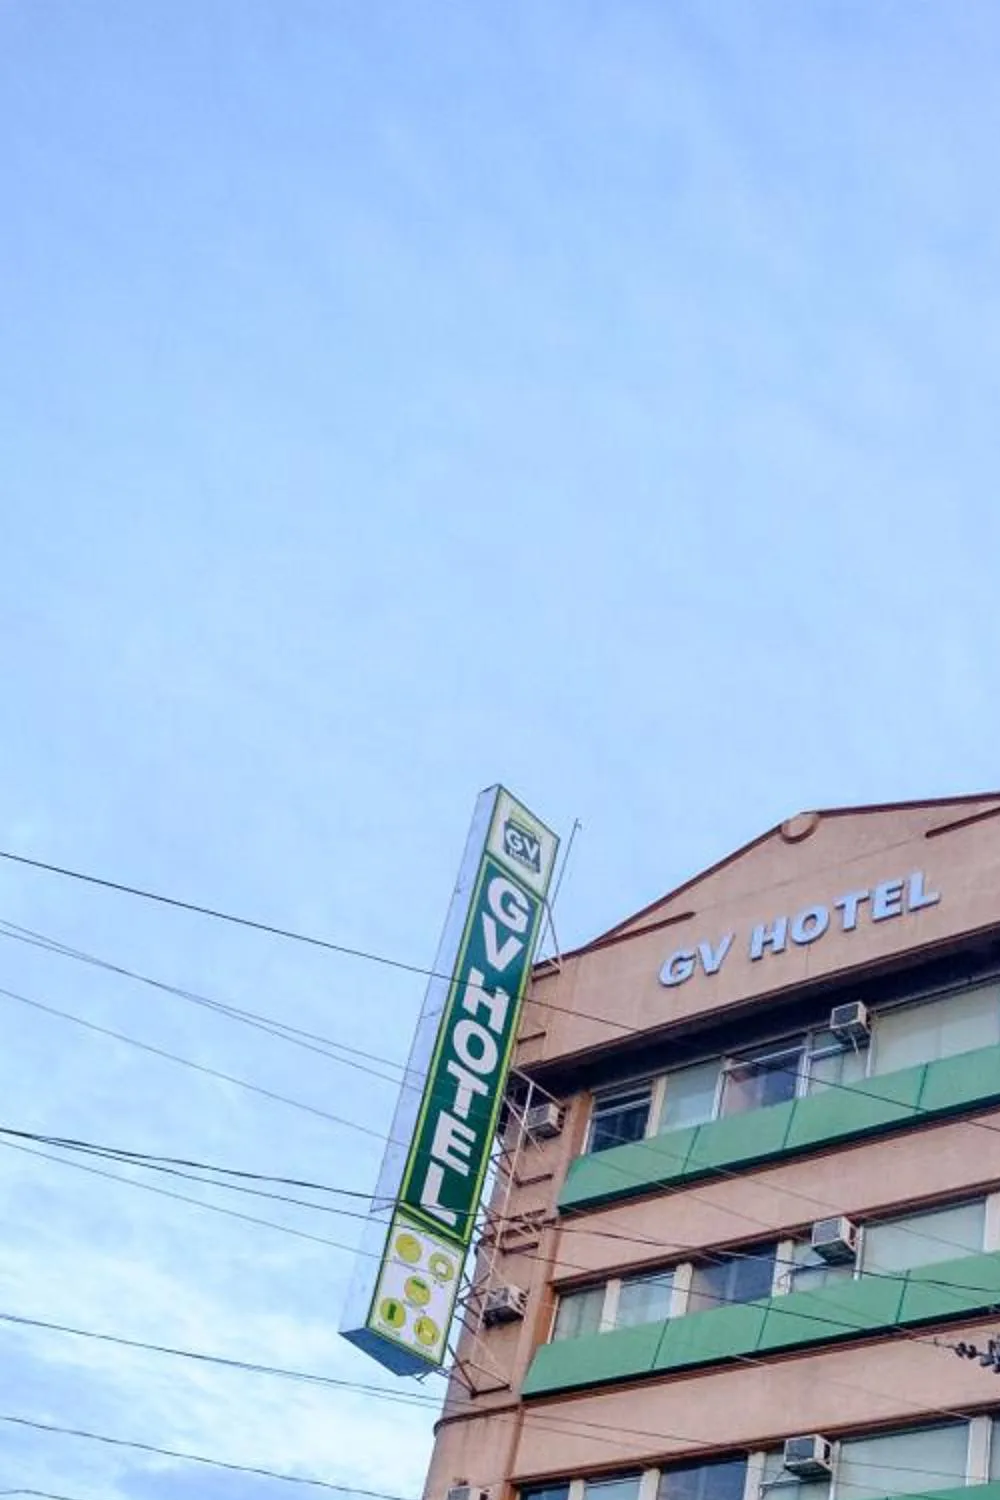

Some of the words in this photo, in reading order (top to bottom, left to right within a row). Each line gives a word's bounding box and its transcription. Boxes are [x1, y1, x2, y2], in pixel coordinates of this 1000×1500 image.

[506, 829, 539, 860] GV
[482, 877, 529, 972] GV
[657, 932, 735, 987] GV
[749, 867, 941, 961] HOTEL
[420, 967, 510, 1226] HOTEL
